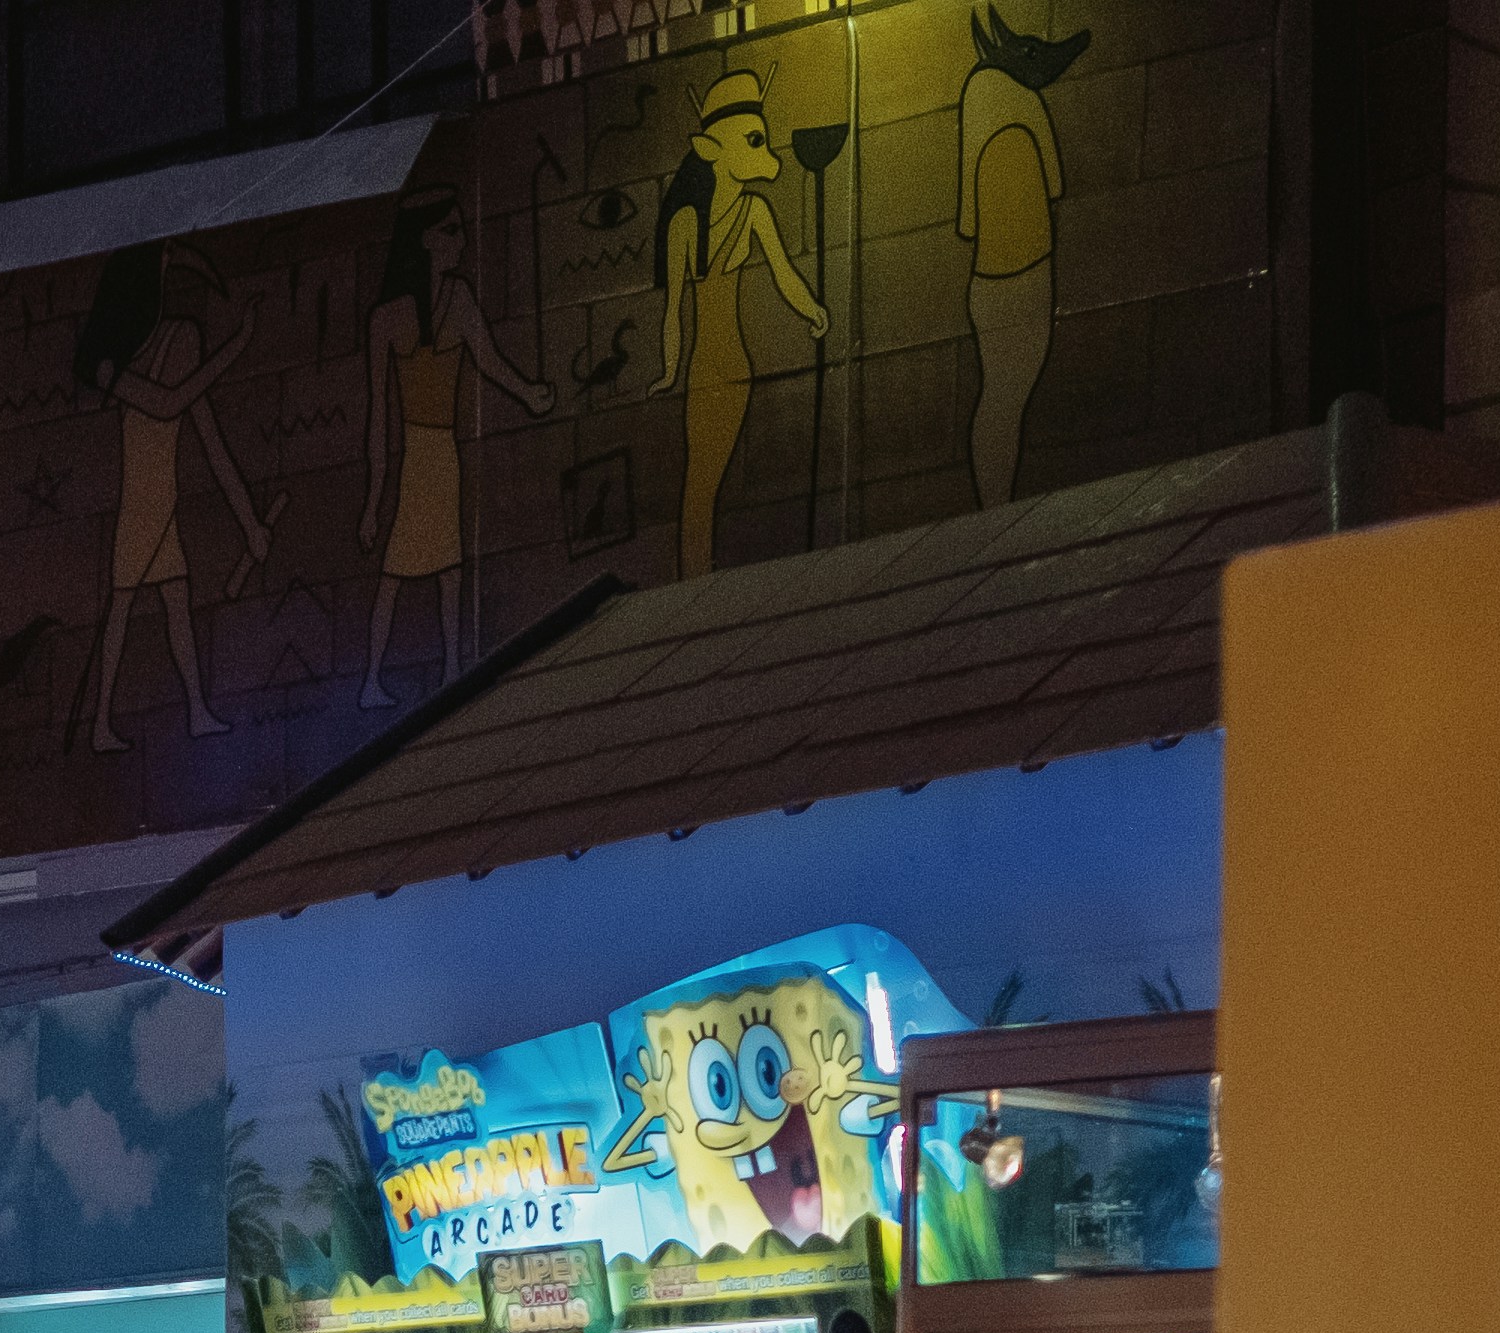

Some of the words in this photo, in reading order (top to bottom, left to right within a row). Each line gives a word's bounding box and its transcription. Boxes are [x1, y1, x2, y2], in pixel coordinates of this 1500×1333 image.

[383, 1128, 595, 1232] PINEAPPLE
[430, 1200, 565, 1258] ARCADE
[491, 1252, 593, 1293] SUPER
[718, 1275, 751, 1292] when
[752, 1274, 775, 1293] you
[778, 1269, 816, 1287] collect
[520, 1285, 569, 1307] CARD
[508, 1299, 590, 1332] BONUS
